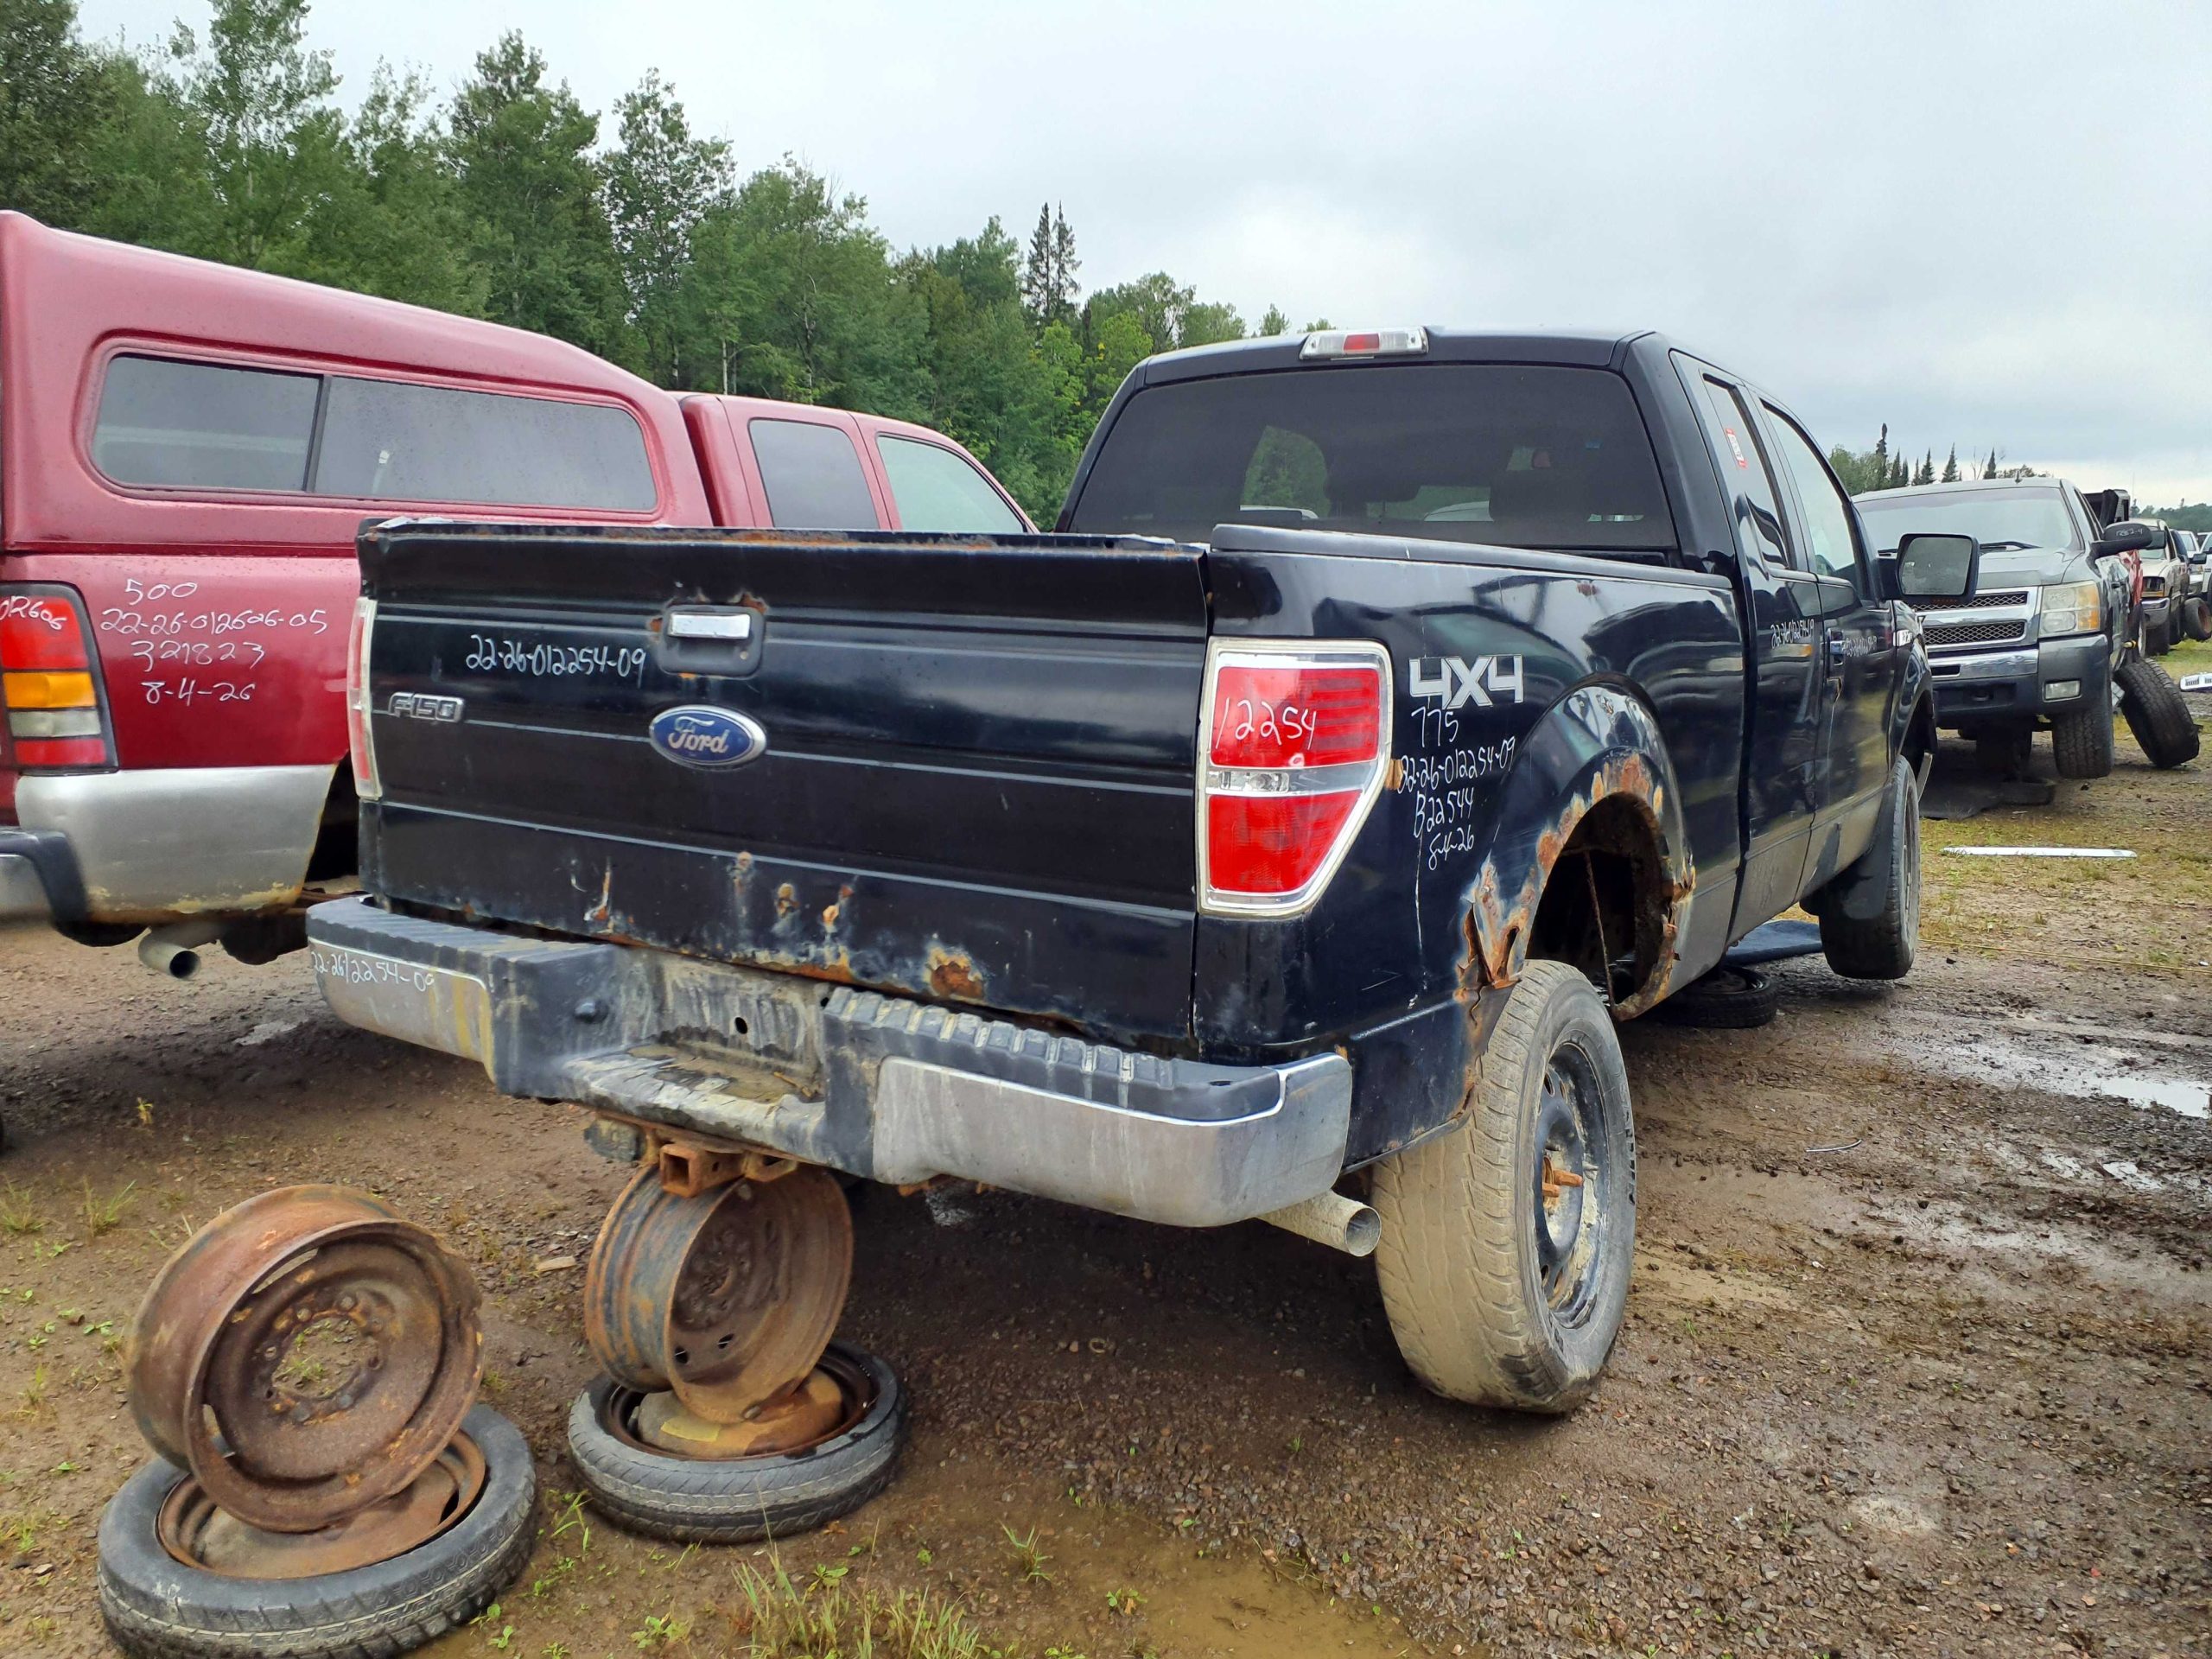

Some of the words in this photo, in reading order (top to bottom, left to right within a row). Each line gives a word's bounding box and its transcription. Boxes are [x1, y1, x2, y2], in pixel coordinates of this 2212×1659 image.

[125, 578, 198, 605] 500
[466, 634, 645, 688] 22-26-012254-09
[141, 677, 256, 707] 8-4-26
[668, 715, 730, 753] Ford
[1215, 696, 1317, 750] 12254
[1411, 706, 1459, 748] 775
